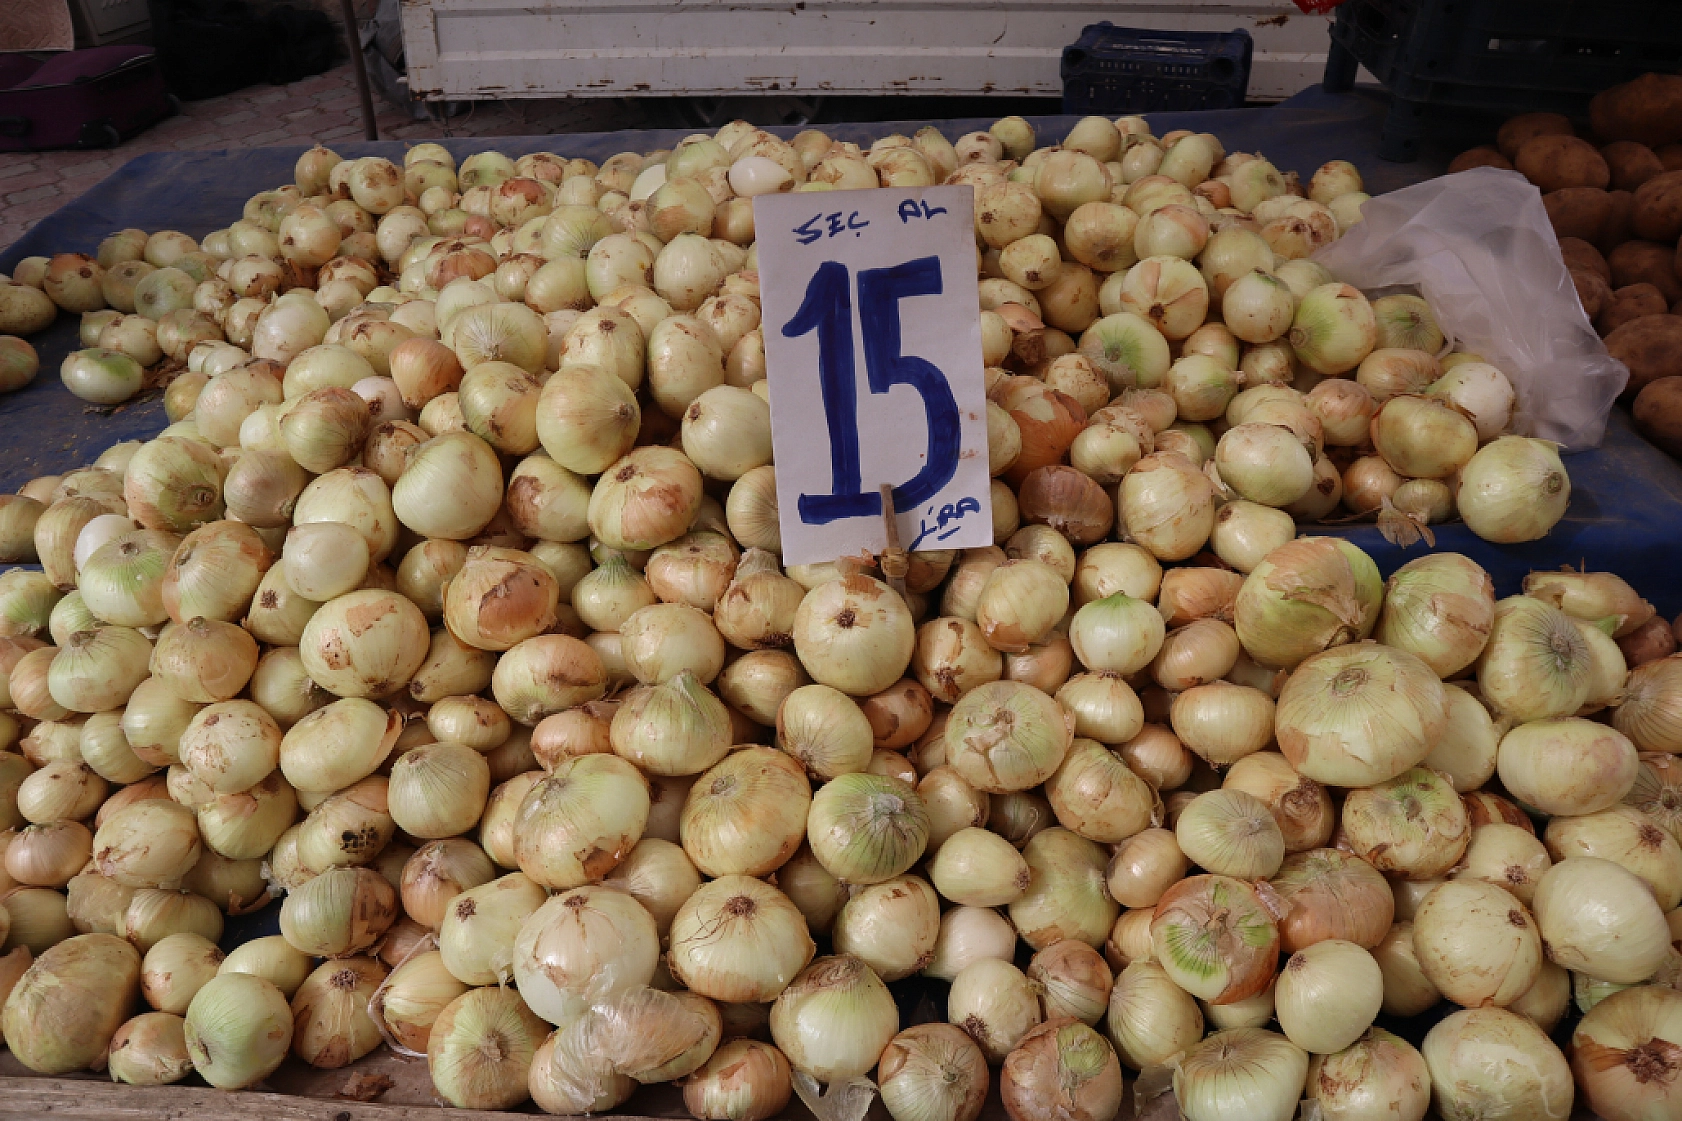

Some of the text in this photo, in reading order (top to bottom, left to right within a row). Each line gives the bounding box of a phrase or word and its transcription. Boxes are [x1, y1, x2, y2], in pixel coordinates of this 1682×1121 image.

[793, 199, 947, 245] SEÇ AL
[781, 256, 961, 525] 15
